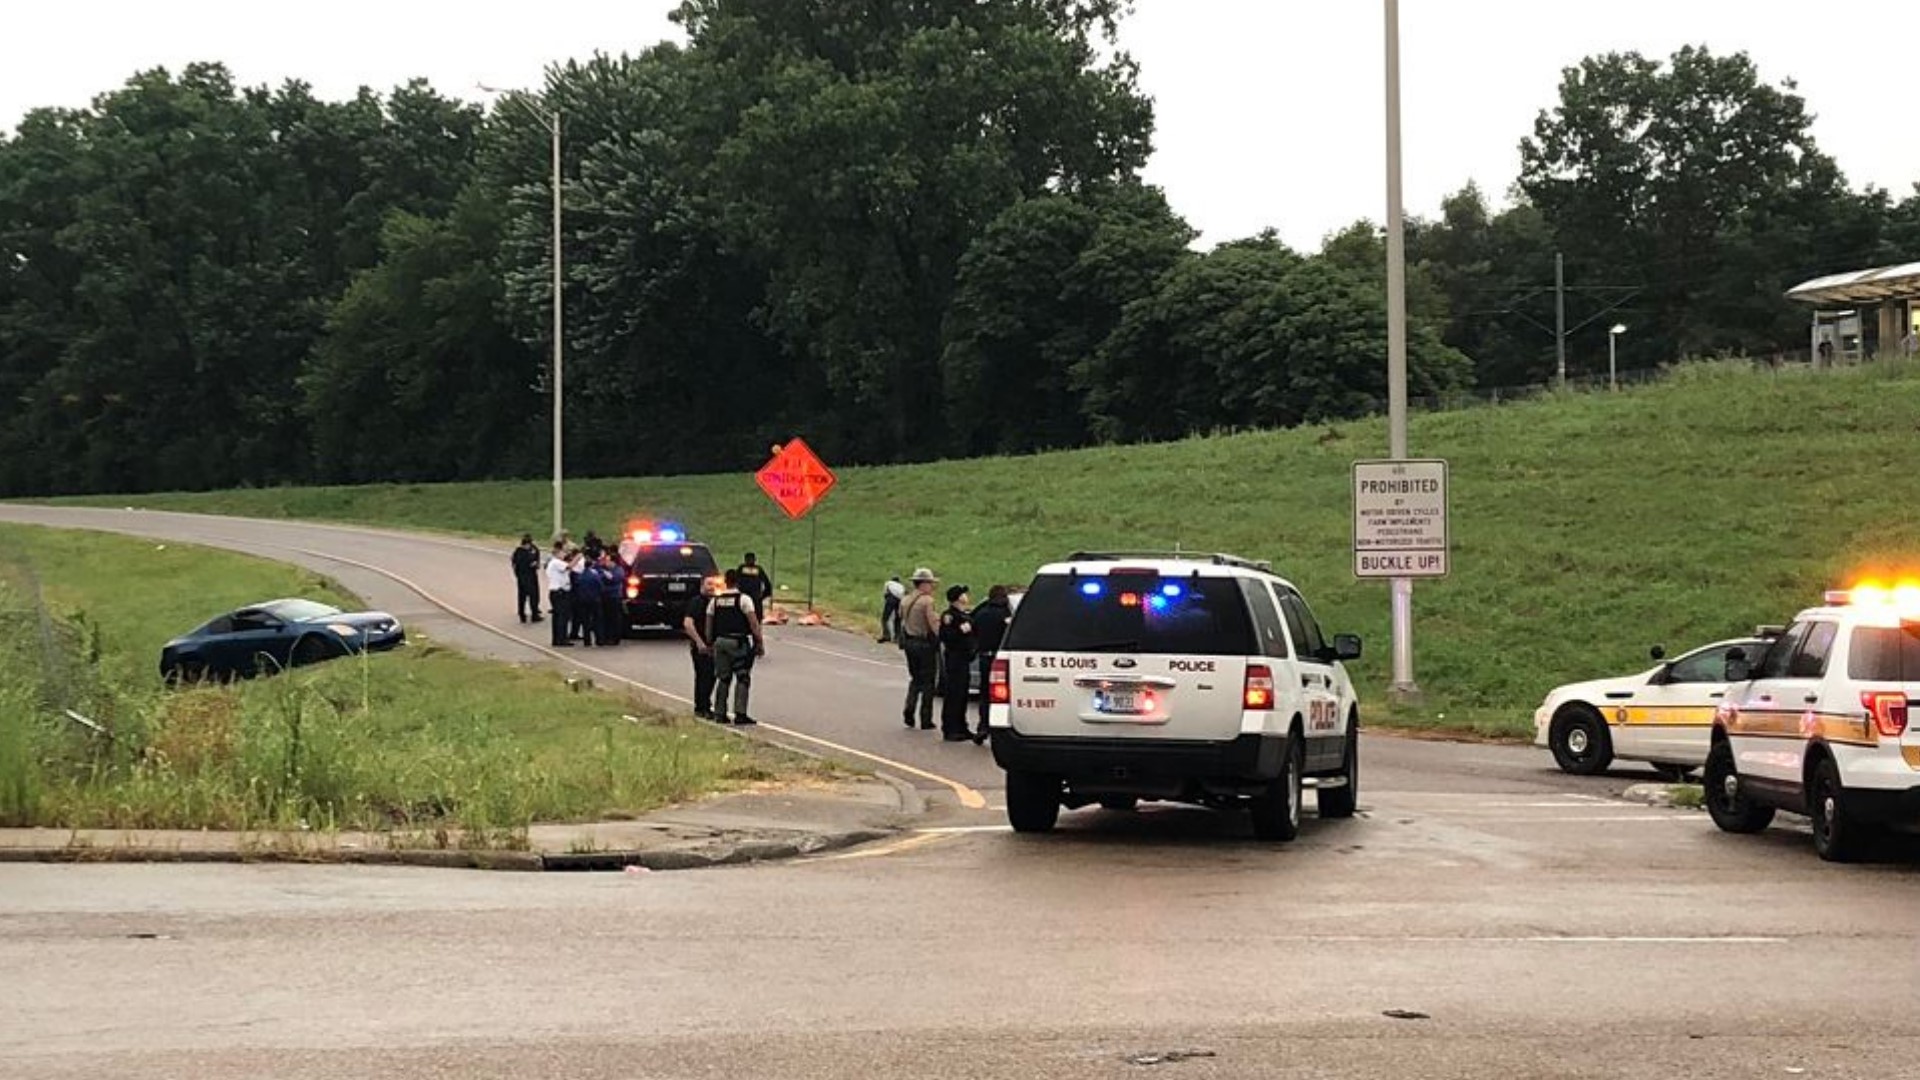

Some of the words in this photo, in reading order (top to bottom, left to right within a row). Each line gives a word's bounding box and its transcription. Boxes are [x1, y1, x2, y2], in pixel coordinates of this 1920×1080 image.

[1361, 479, 1438, 493] PROHIBITED
[1386, 508, 1411, 516] DRIVEN
[1389, 518, 1431, 526] IMPLEMENTS
[1377, 528, 1423, 536] PEDESTRIANS
[1357, 538, 1413, 546] NON-MOTORIZED
[1416, 537, 1442, 546] TRAFFIC
[1361, 556, 1413, 570] BUCKLE
[1418, 555, 1440, 569] UP!
[1060, 657, 1098, 669] LOUIS
[1169, 660, 1215, 672] POLICE
[1035, 699, 1056, 708] UNIT
